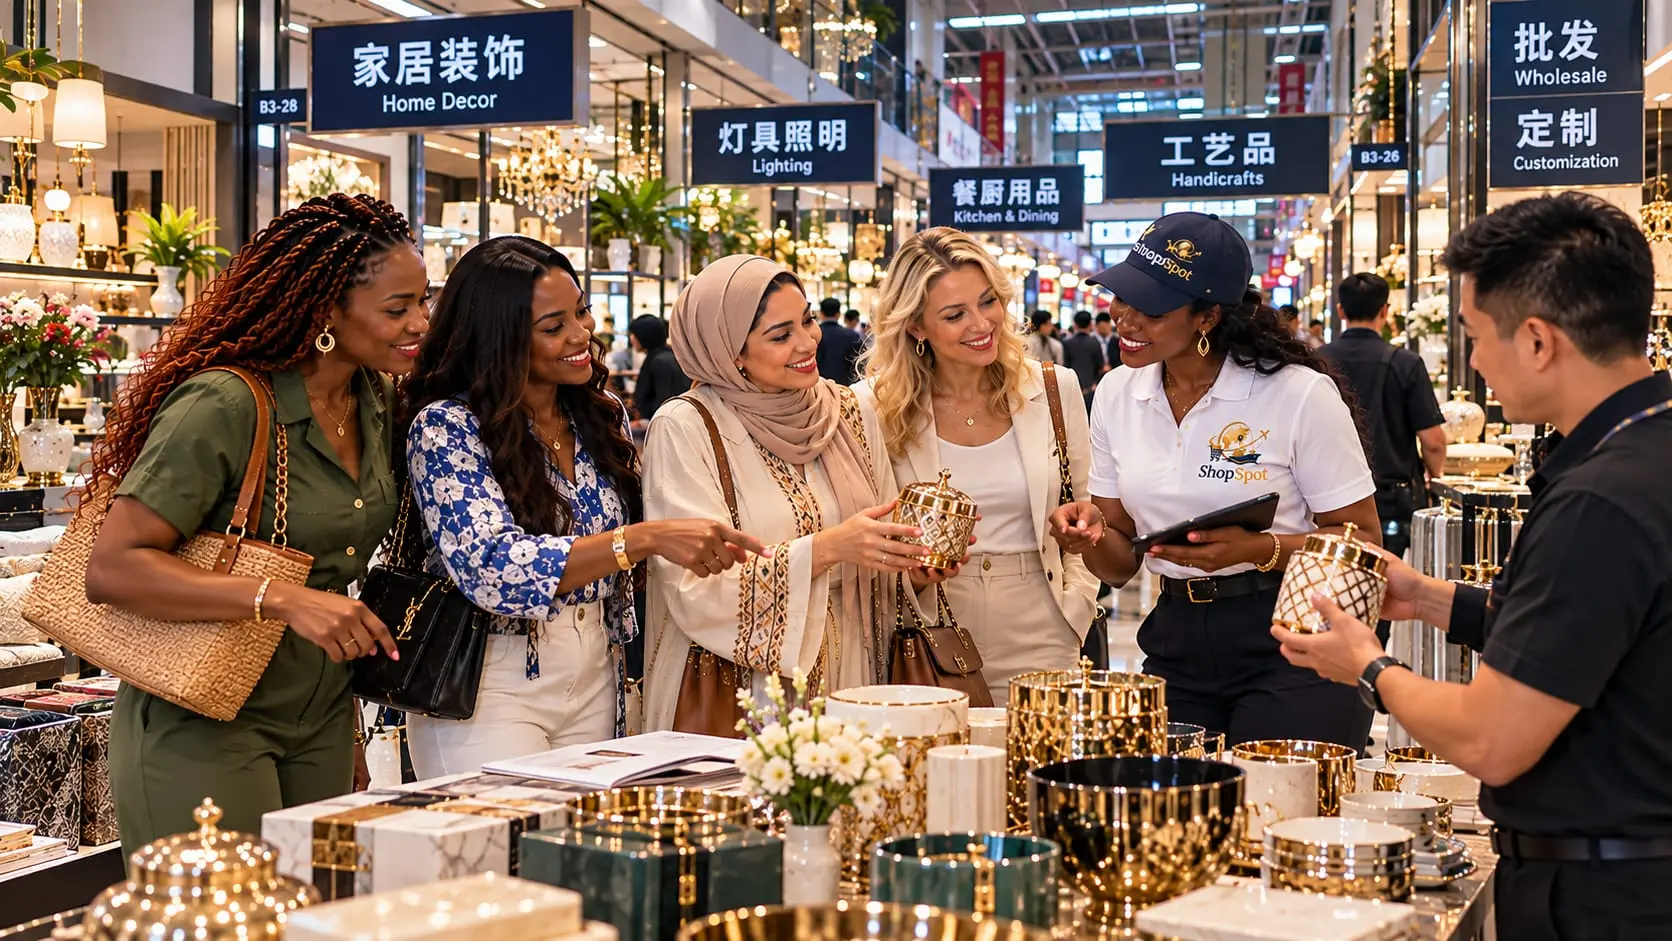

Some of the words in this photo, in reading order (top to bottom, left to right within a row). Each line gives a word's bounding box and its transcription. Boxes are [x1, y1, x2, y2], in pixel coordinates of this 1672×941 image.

[1513, 19, 1600, 63] 批发
[353, 34, 525, 87] 家居装饰
[1514, 66, 1608, 87] Wholesale
[259, 98, 298, 114] B3-28
[382, 93, 436, 112] Home
[442, 91, 498, 111] Decor
[718, 119, 848, 154] 灯具照明
[1516, 107, 1598, 149] 定制
[1160, 132, 1276, 167] 工艺品
[1360, 149, 1401, 164] B3-26
[752, 157, 814, 178] Lighting
[1513, 152, 1620, 171] Customization
[1171, 170, 1265, 187] Handicrafts
[952, 177, 1060, 207] 餐厨用品
[953, 208, 1002, 223] Kitchen
[1004, 209, 1016, 222] &
[1018, 209, 1060, 225] Dining
[1197, 464, 1268, 484] ShopSpot
